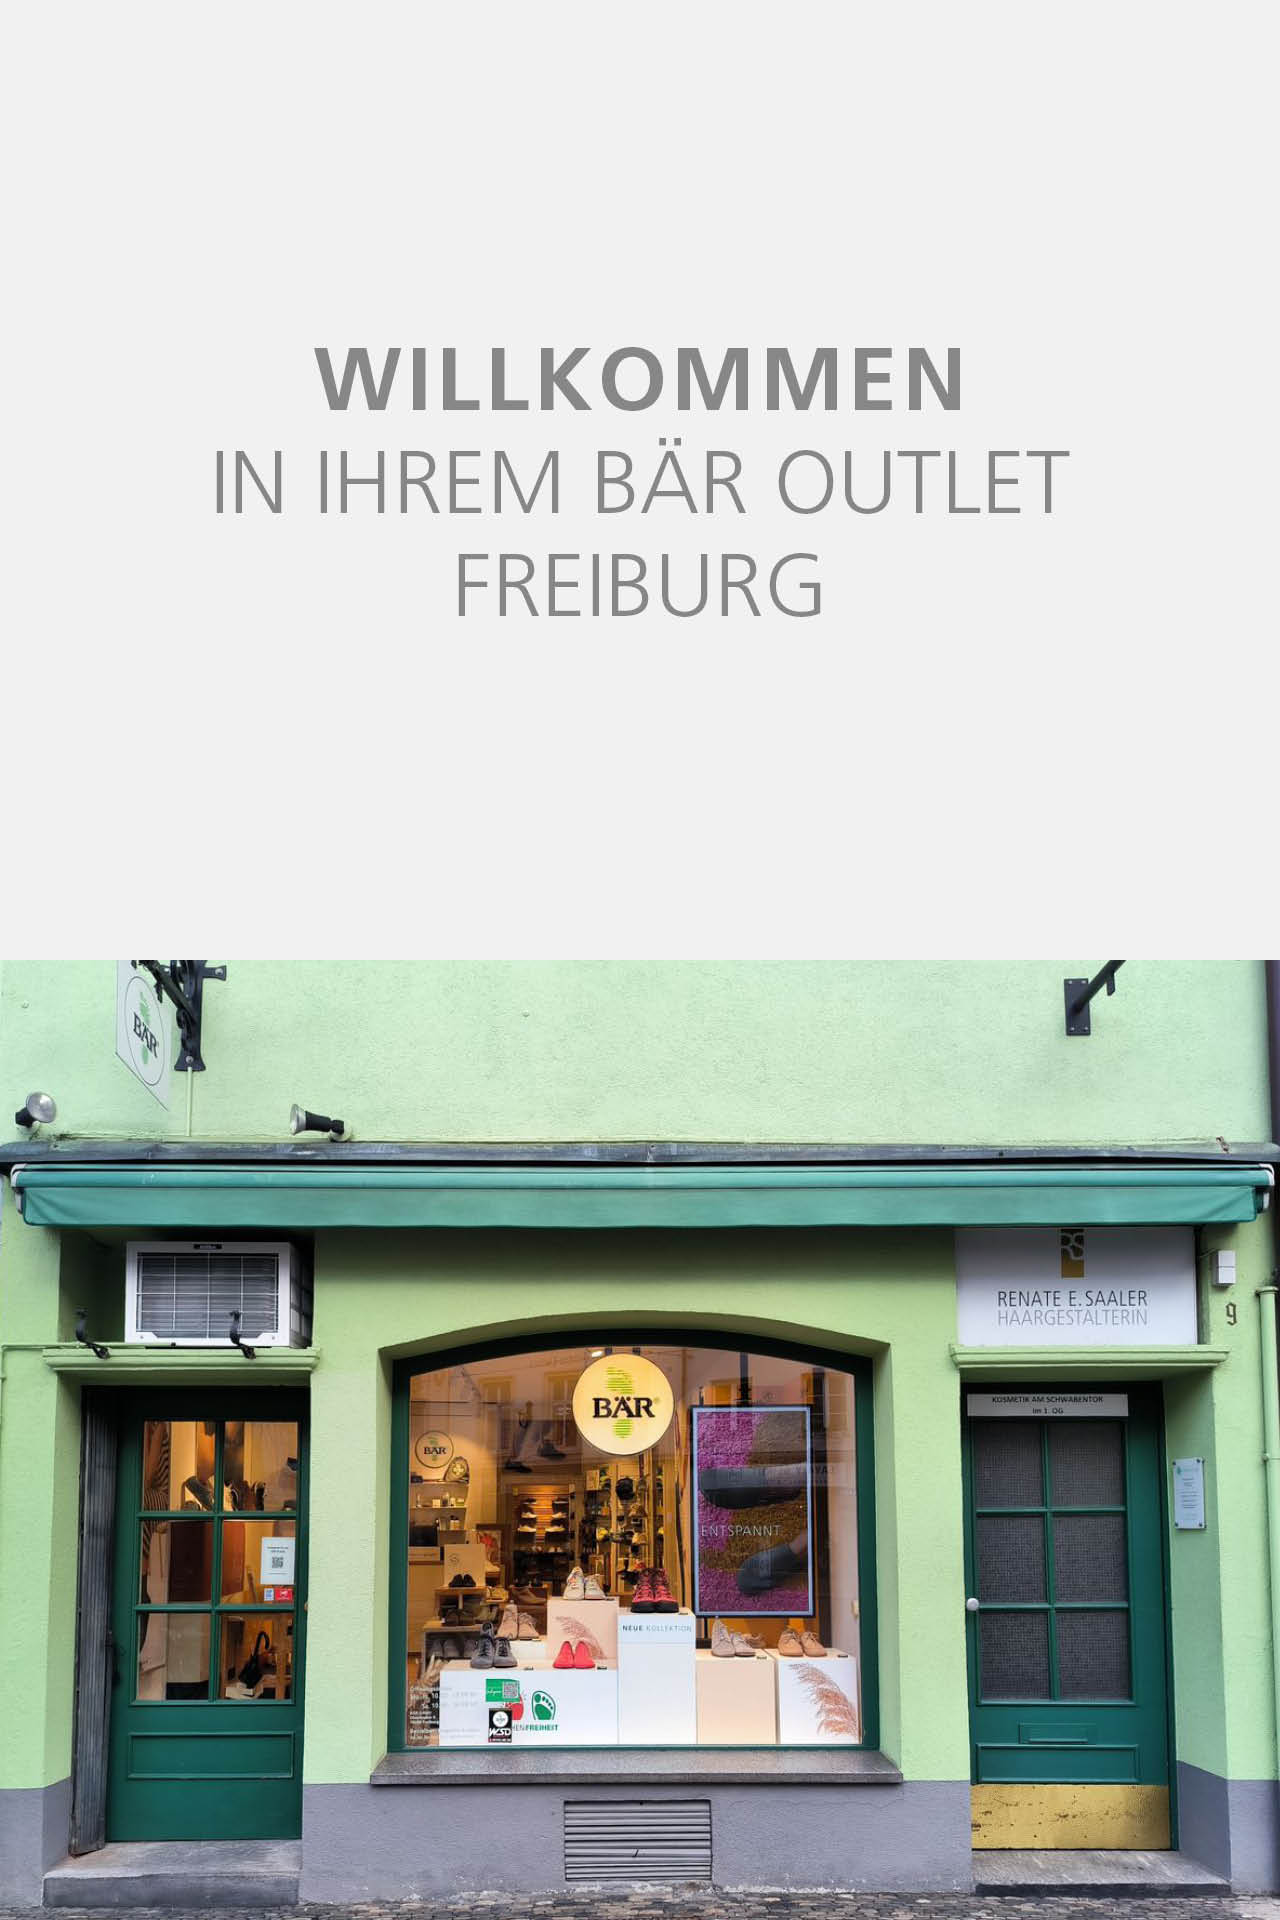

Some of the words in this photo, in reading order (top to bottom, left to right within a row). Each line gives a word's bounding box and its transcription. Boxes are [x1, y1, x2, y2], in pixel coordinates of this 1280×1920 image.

[997, 1290, 1061, 1307] RENATE
[1068, 1290, 1082, 1307] E.
[1085, 1290, 1148, 1307] SAALER
[997, 1308, 1148, 1326] HAARGESTALTERIN
[1226, 1302, 1238, 1326] 9
[592, 1394, 656, 1419] BÄR
[991, 1395, 1030, 1404] KOSMETIK
[1031, 1395, 1045, 1404] AM
[1046, 1395, 1104, 1404] SCHWABENTOR
[700, 1523, 781, 1538] ENTSPANNT
[622, 1624, 643, 1632] NEUE
[646, 1624, 692, 1632] KOLLEKTION
